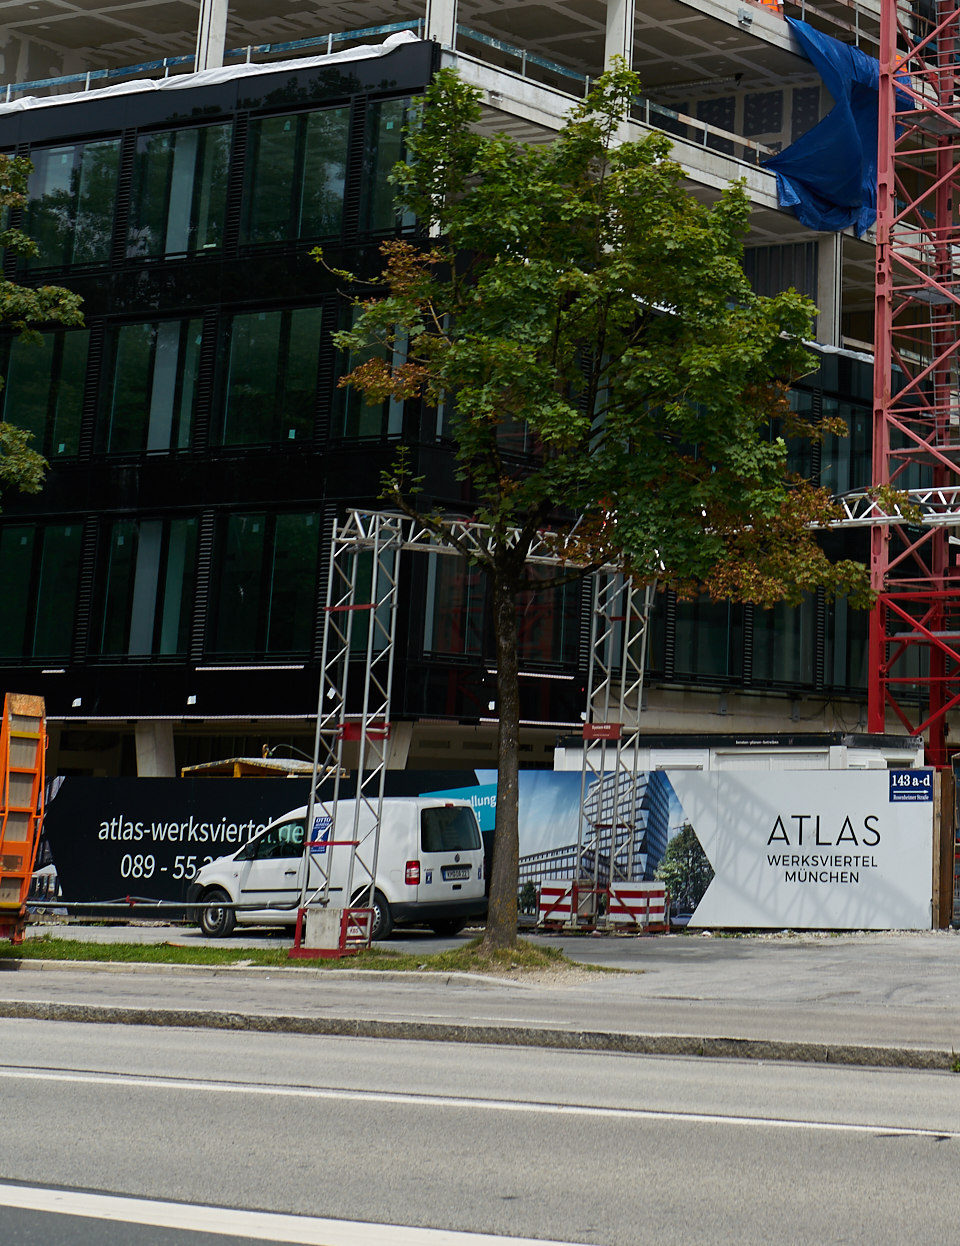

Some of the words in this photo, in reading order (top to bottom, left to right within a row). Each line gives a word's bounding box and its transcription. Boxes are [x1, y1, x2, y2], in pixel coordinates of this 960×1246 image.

[891, 774, 911, 787] 143
[912, 774, 931, 787] a-d
[766, 814, 882, 847] ATLAS
[119, 853, 156, 879] 089
[172, 854, 198, 880] 55
[767, 854, 878, 868] WERKSVIERTEL
[784, 868, 860, 884] MÜNCHEN
